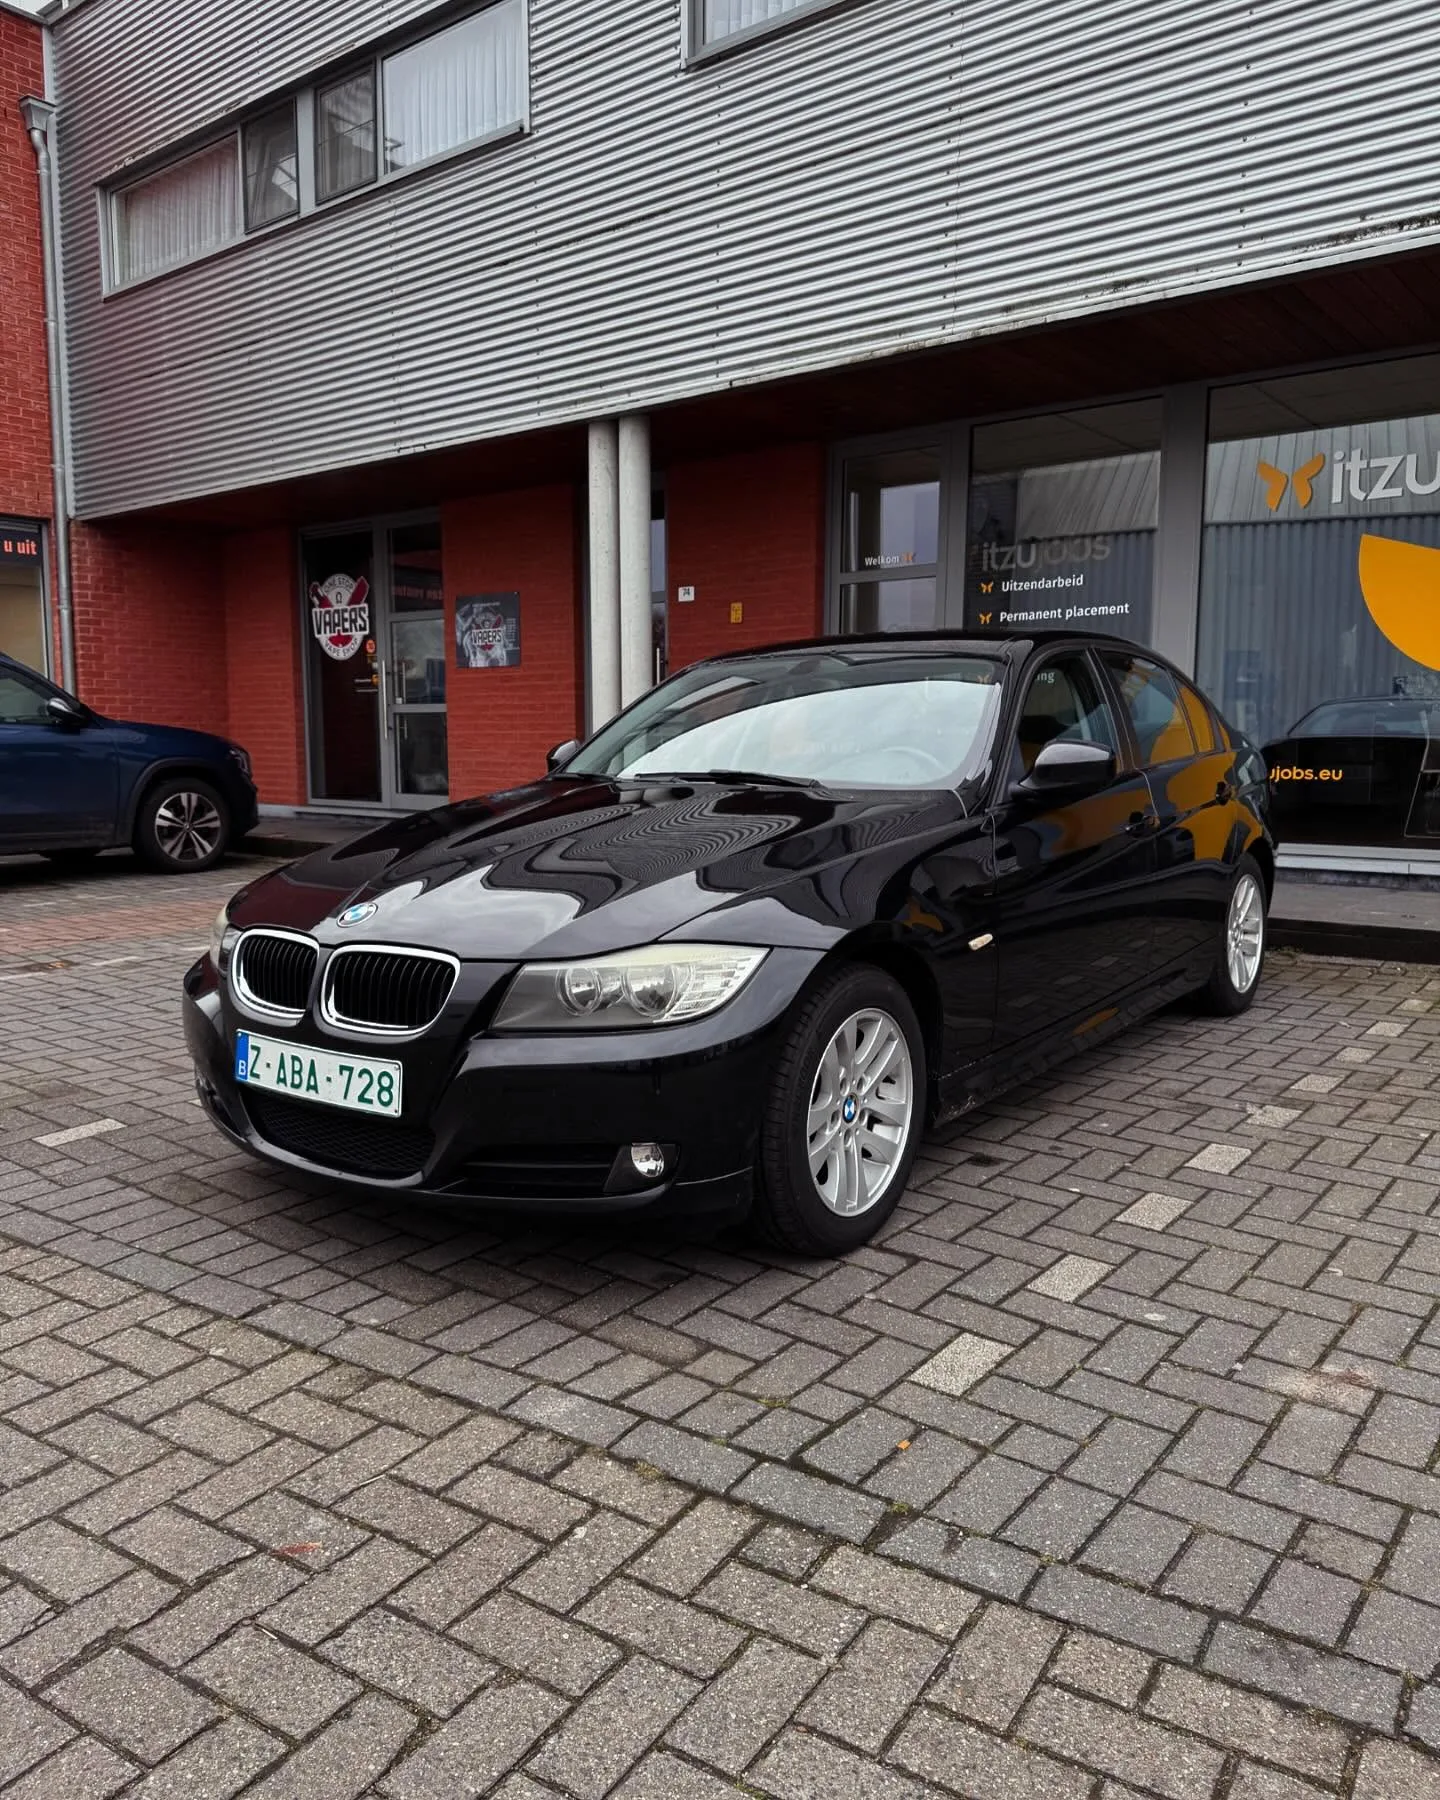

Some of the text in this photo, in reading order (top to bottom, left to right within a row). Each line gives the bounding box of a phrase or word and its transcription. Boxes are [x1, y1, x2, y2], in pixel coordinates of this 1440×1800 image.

[1331, 448, 1440, 504] itzu
[4, 539, 37, 555] u uit
[864, 554, 900, 567] Welkom
[1001, 574, 1084, 593] Uitzendarbeid
[313, 605, 368, 636] VAPERS
[1000, 602, 1130, 623] Permanent placement
[472, 629, 502, 644] VAPERS
[238, 1059, 247, 1076] B
